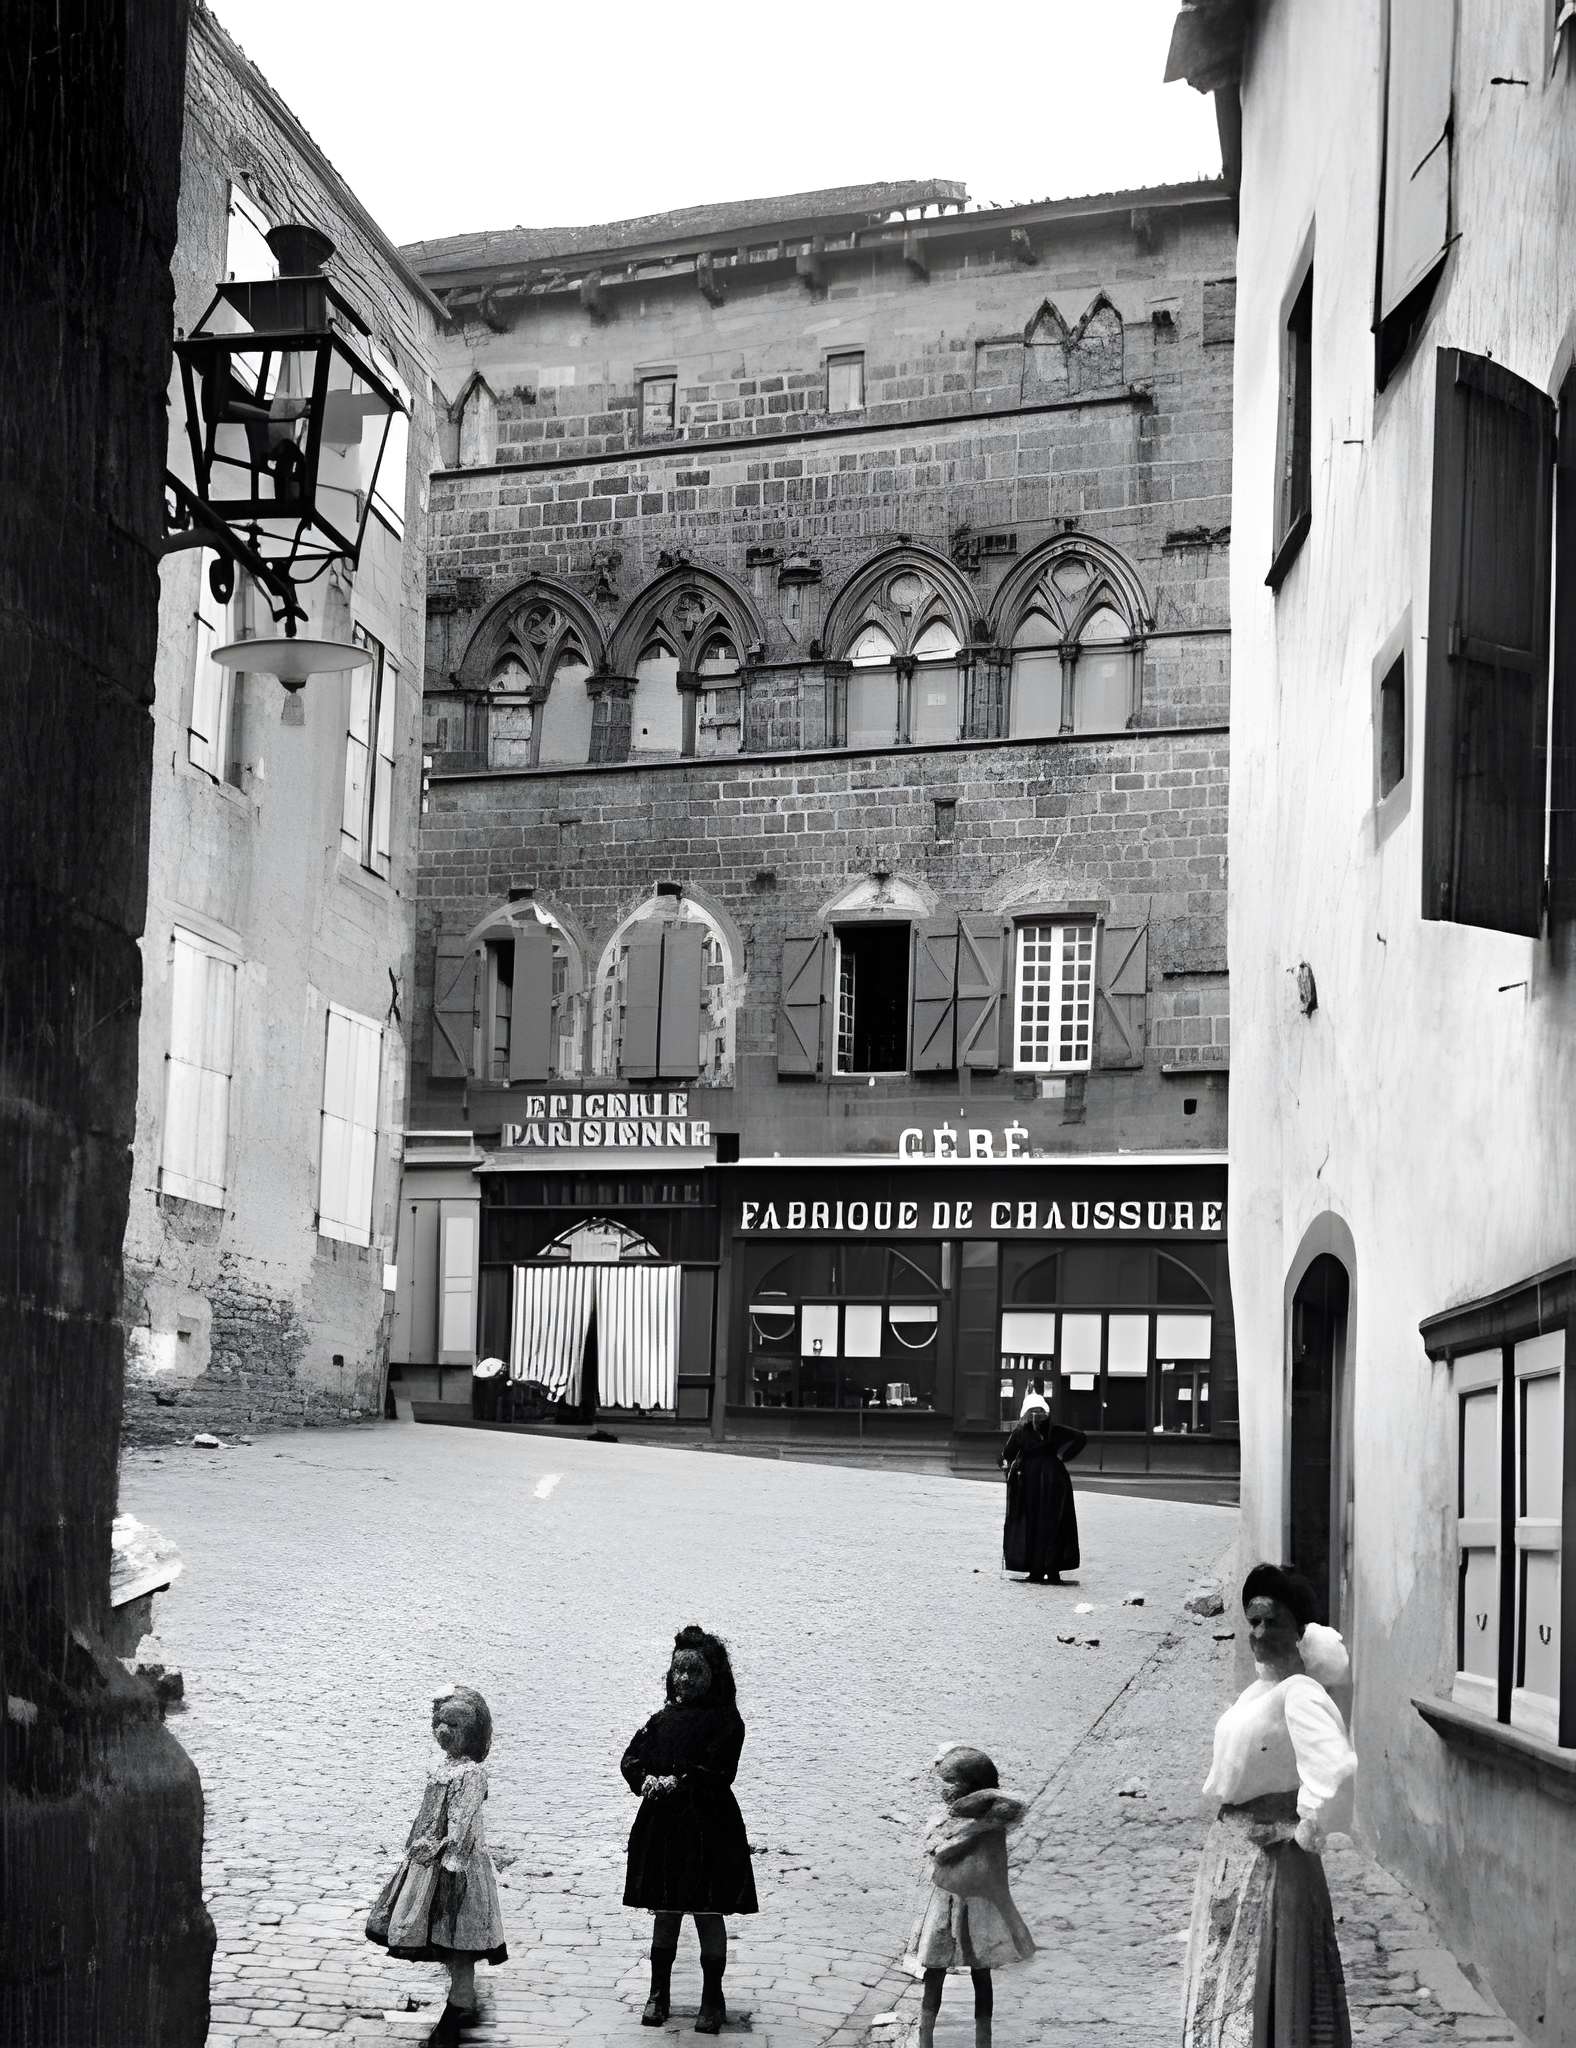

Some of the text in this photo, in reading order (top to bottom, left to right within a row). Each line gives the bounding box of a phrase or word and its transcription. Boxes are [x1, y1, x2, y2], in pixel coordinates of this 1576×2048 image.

[740, 1200, 1223, 1231] FABRIQUE DE CHAUSSURE
